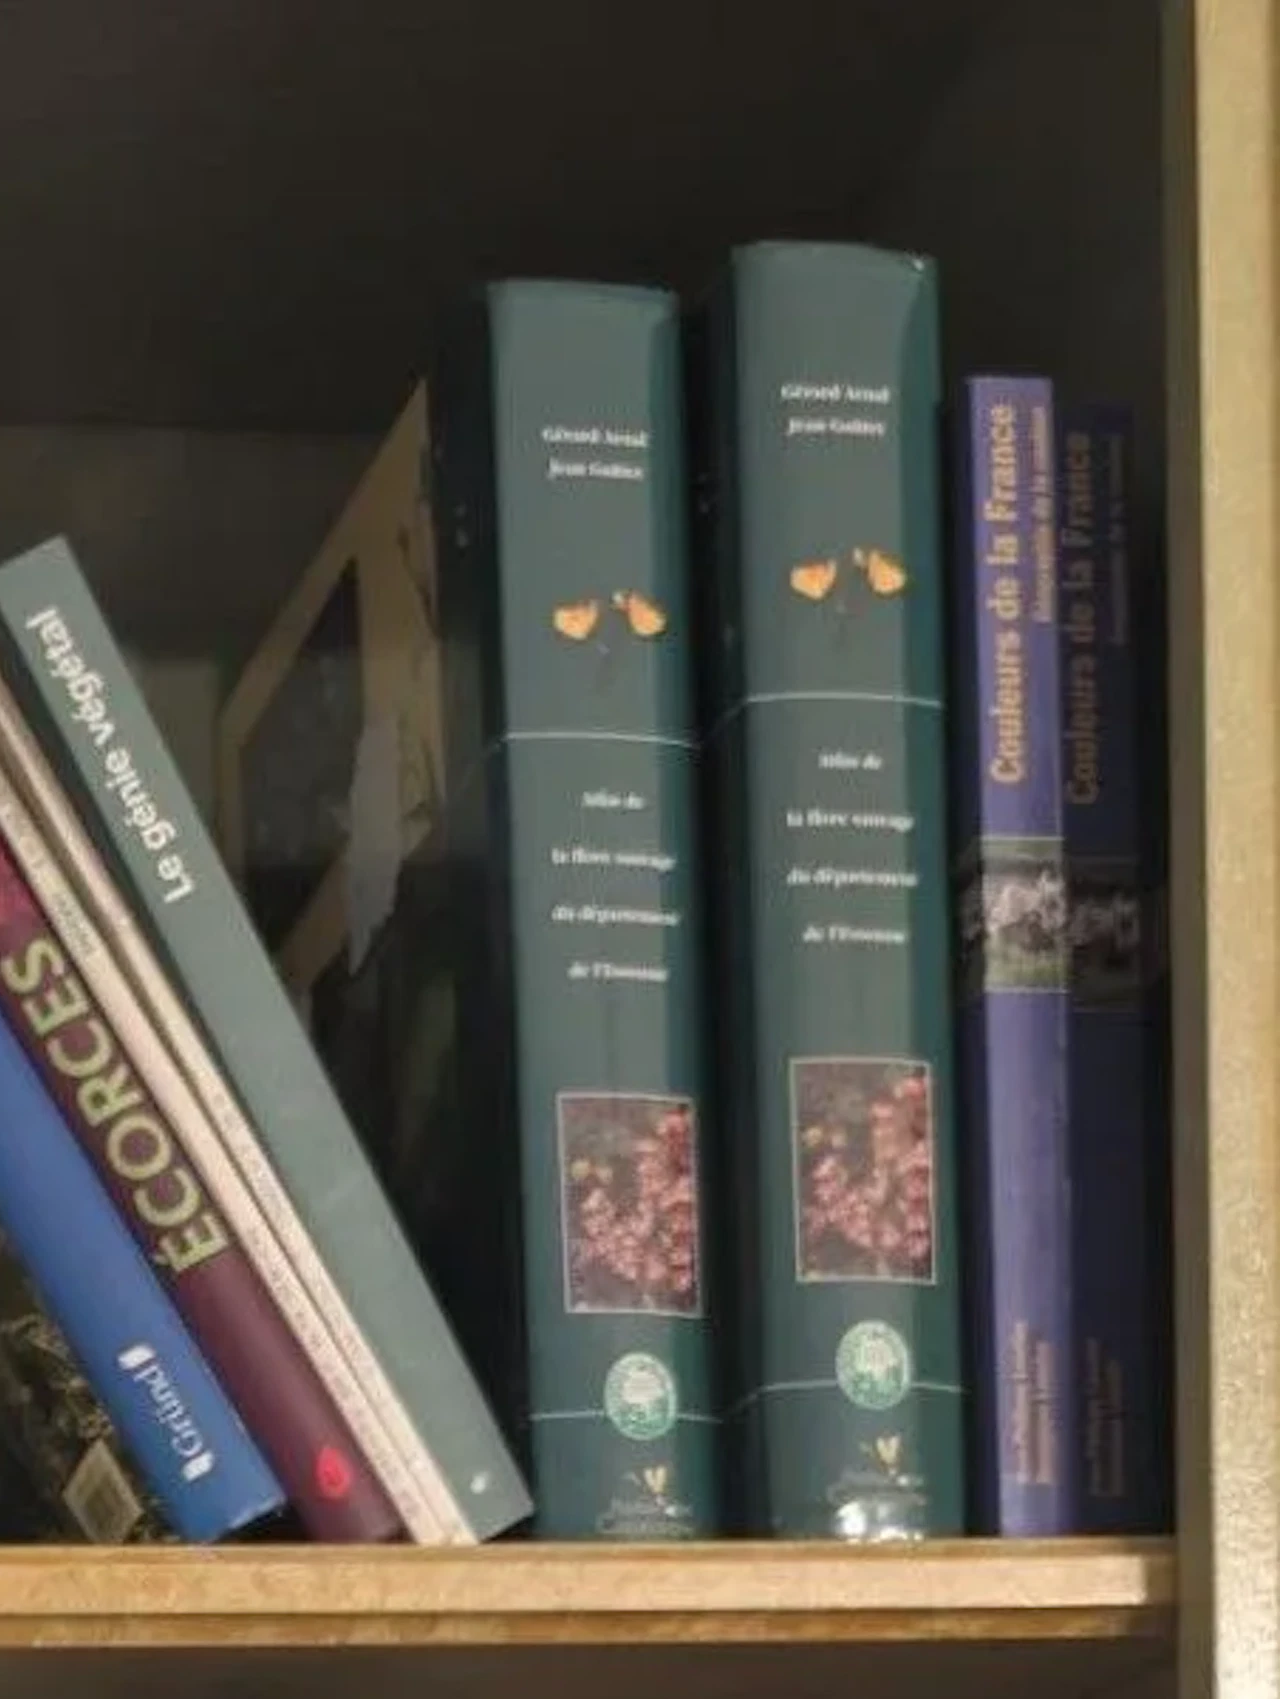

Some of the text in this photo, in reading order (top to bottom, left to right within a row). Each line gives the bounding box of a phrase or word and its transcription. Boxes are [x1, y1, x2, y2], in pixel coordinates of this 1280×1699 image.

[24, 606, 194, 902] Le génie végétal
[983, 404, 1028, 783] Couleurs de la France
